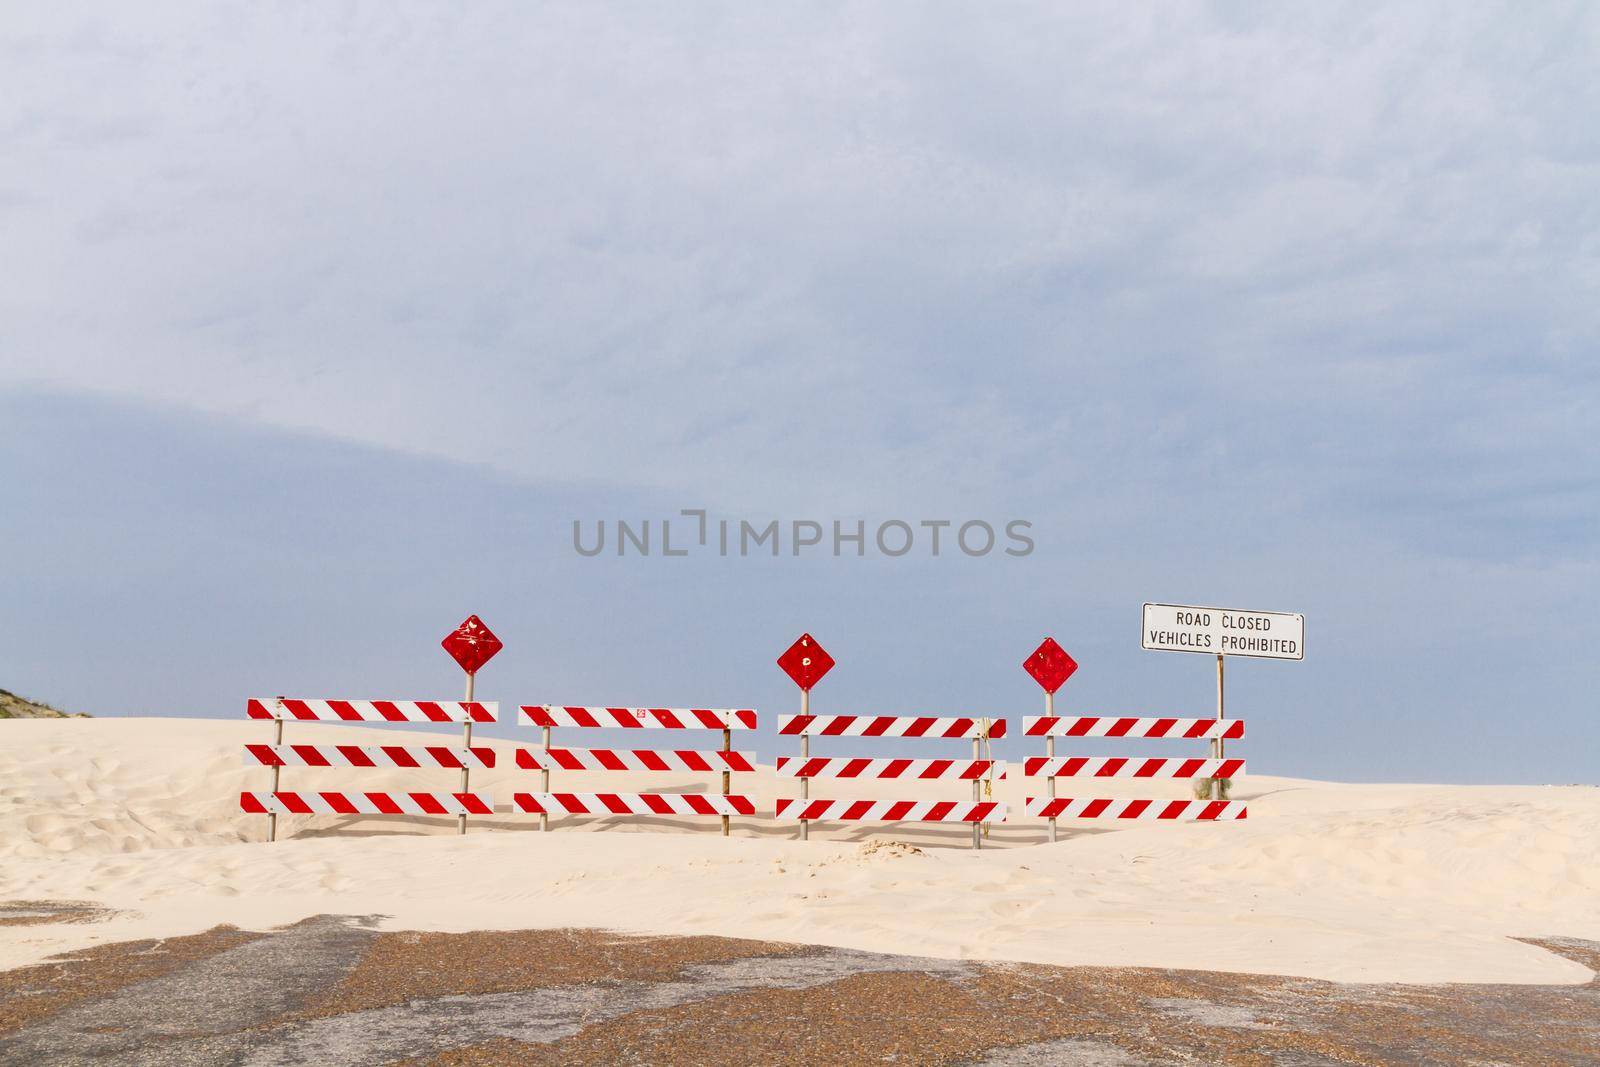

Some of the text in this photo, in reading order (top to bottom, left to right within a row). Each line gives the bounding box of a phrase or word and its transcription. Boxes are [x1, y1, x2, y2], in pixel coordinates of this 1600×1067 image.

[1176, 612, 1271, 631] ROAD CLOSED
[1150, 630, 1297, 654] VEHICLES PROHIBITED
